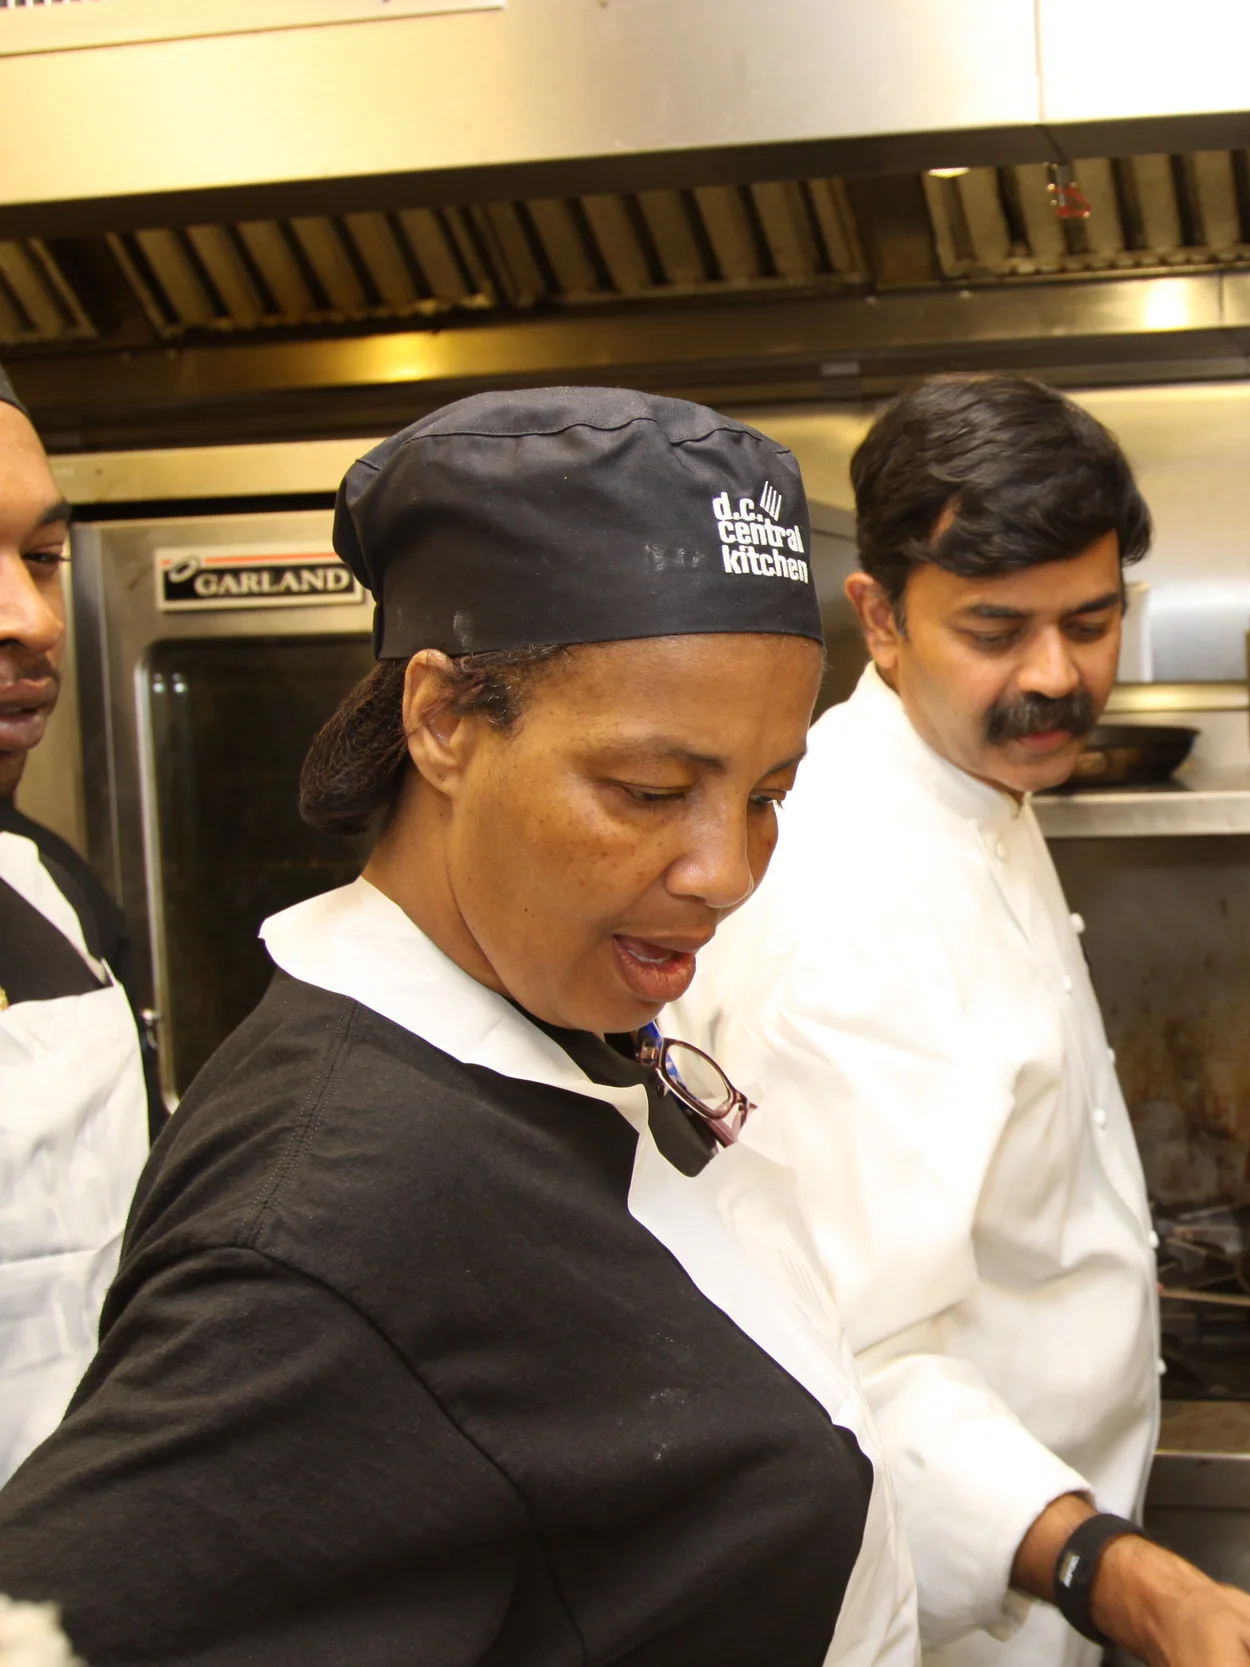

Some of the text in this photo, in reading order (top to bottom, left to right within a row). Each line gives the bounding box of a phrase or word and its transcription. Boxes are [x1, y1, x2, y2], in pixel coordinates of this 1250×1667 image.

[712, 491, 764, 522] d.c.
[717, 518, 805, 553] central
[721, 545, 809, 584] kitchen
[193, 567, 351, 597] GARLAND
